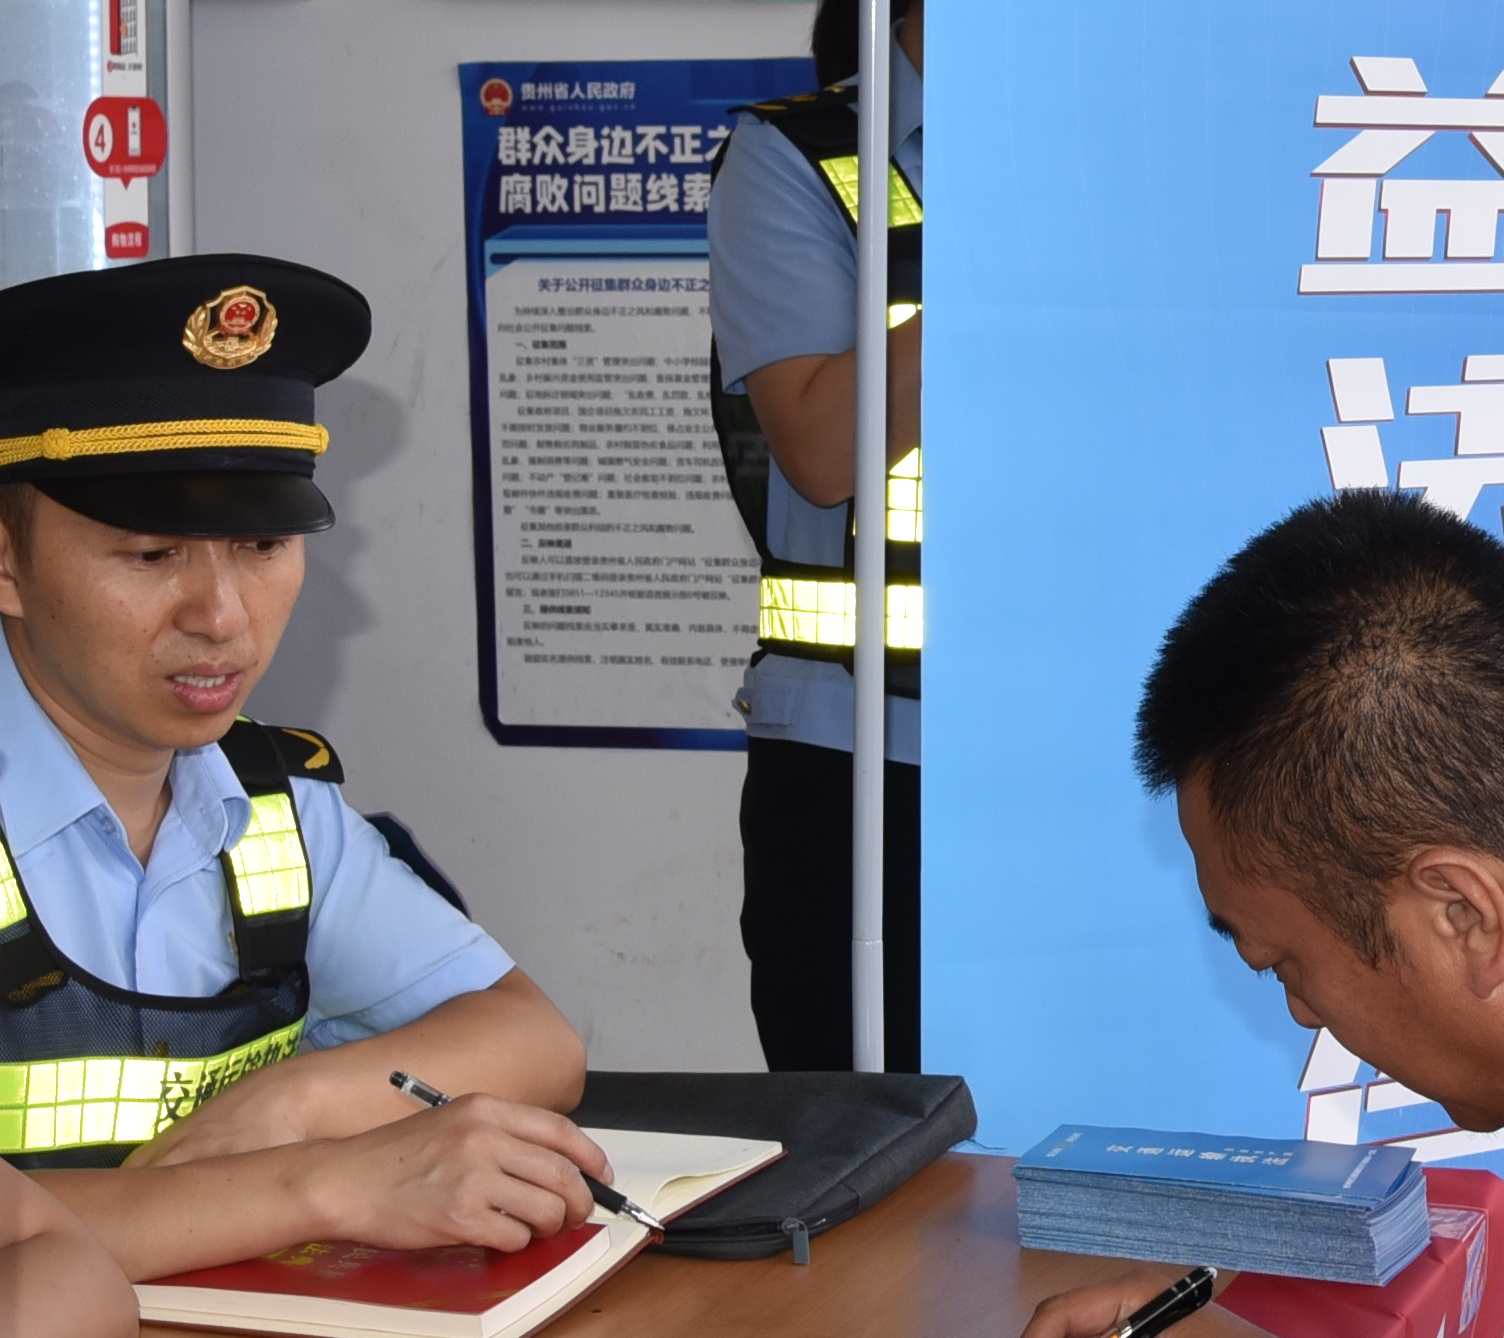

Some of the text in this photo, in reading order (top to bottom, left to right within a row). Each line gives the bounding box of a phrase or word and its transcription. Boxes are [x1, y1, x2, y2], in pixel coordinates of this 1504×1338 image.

[520, 81, 636, 101] 贵州省人民政府
[94, 123, 107, 154] 4
[499, 172, 711, 214] 腐败问题线索
[538, 277, 710, 293] 关于公开征集群众身边不正之
